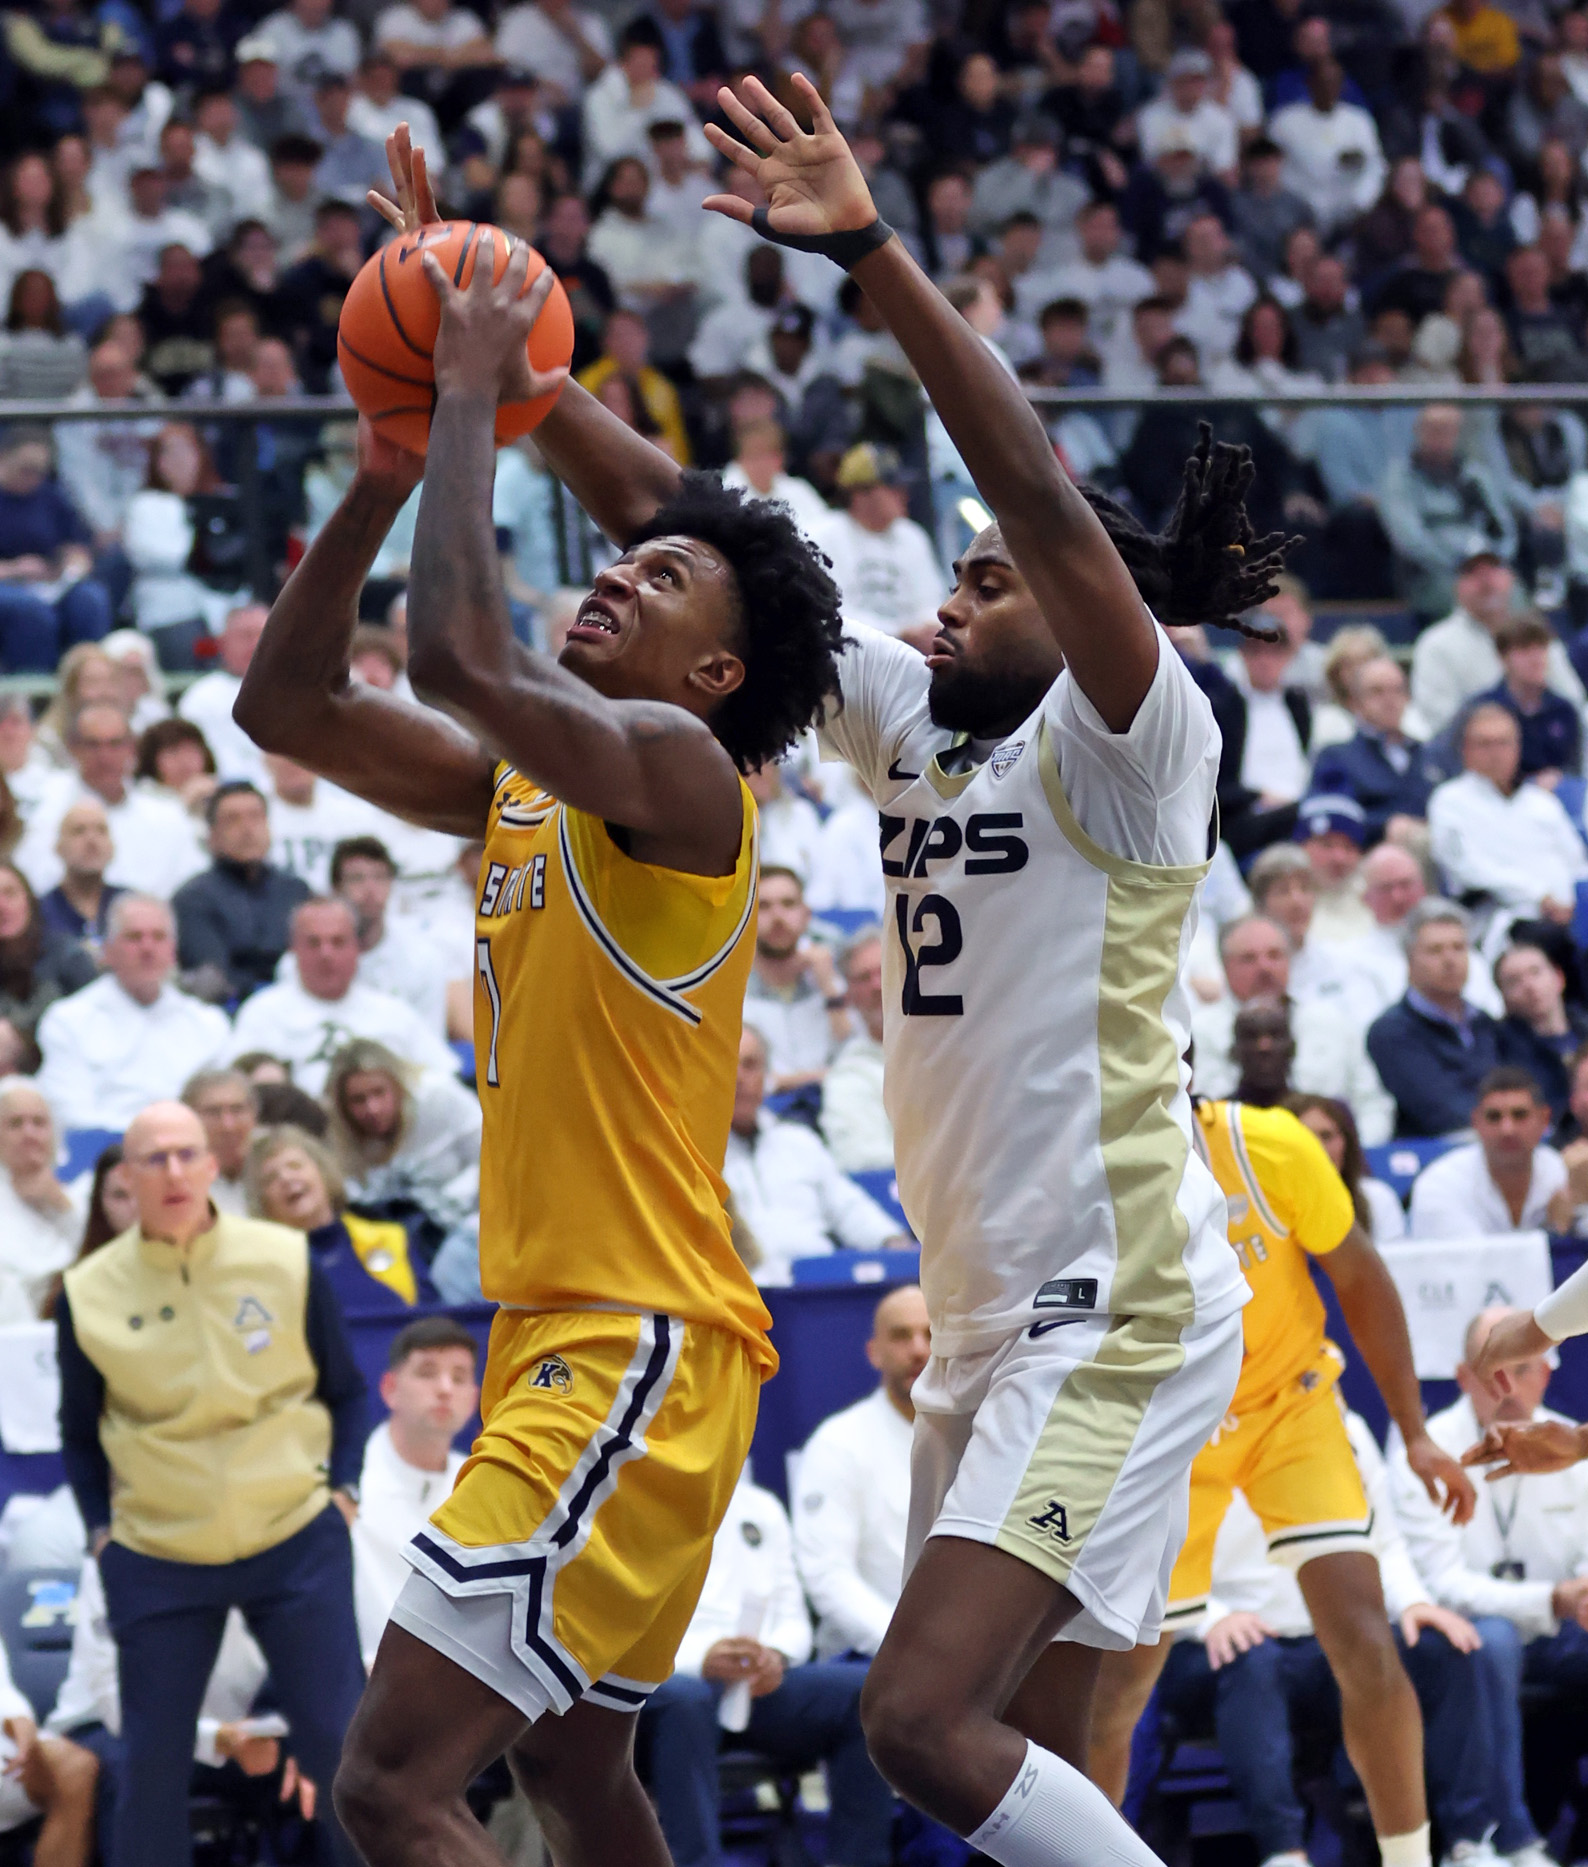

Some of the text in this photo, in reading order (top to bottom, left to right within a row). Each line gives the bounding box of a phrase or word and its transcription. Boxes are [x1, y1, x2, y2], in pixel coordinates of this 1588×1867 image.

[879, 811, 1029, 878] ZIPS
[896, 894, 964, 1016] 12
[1078, 1287, 1086, 1300] L
[1028, 1501, 1071, 1543] A
